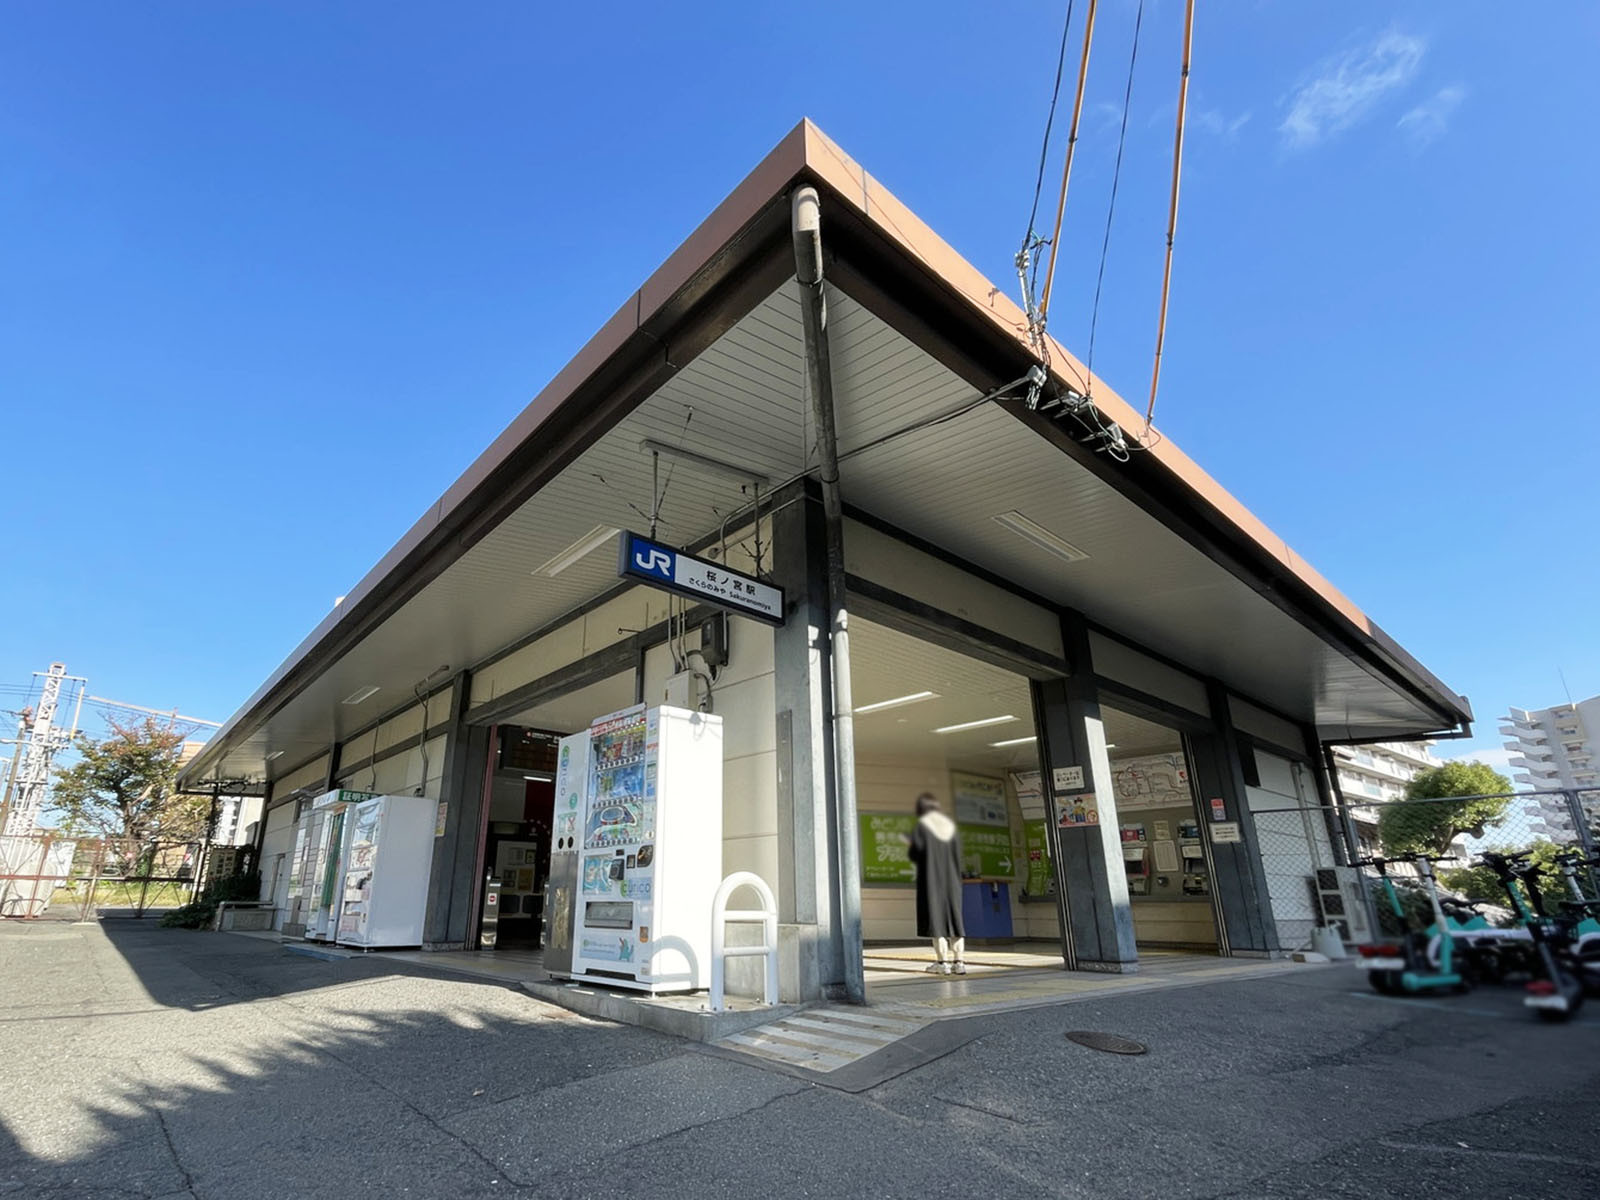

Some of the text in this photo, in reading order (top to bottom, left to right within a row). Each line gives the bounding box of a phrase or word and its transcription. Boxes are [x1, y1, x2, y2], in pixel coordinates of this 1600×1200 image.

[636, 549, 671, 576] JR
[688, 577, 772, 611] さくらのみや Sakuranomiya
[706, 570, 756, 596] 桜ノ宮駅
[343, 791, 379, 801] 証明写
